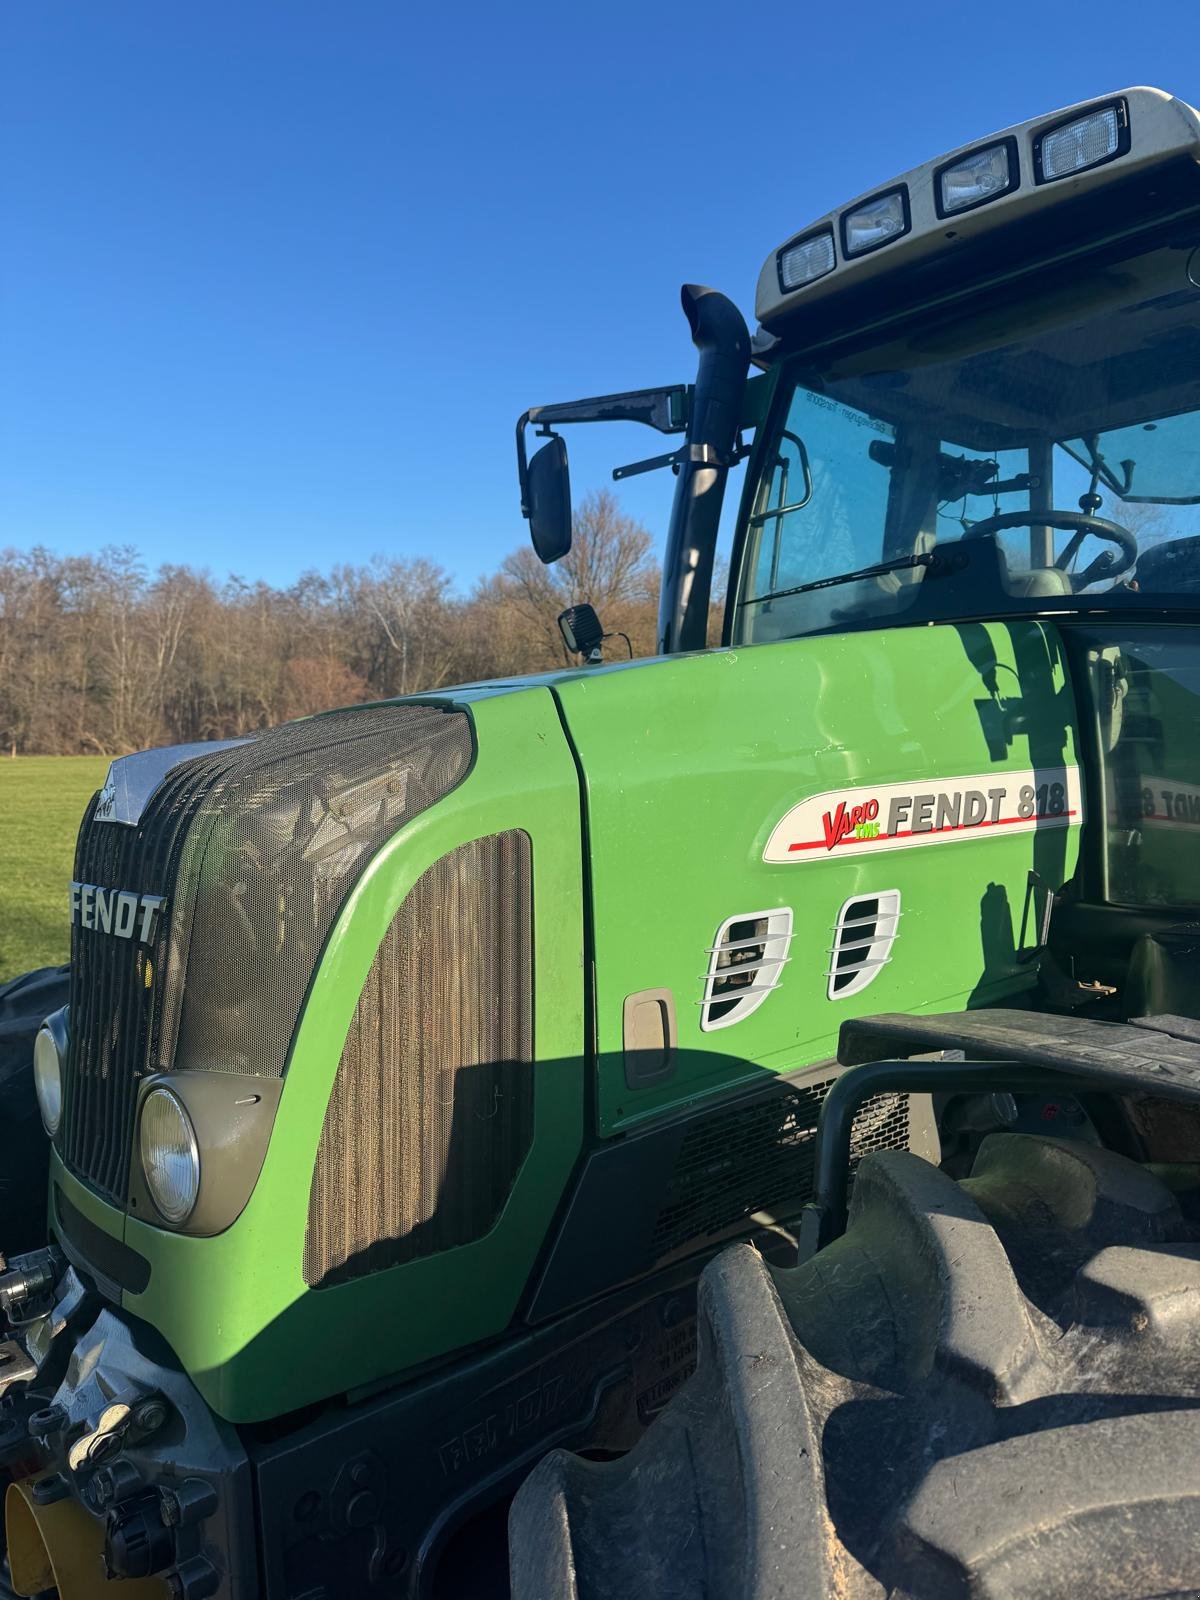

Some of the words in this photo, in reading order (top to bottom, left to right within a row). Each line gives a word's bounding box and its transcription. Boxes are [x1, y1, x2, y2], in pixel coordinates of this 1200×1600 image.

[855, 822, 880, 840] TMS
[887, 788, 1007, 837] FENDT
[1017, 782, 1065, 818] 818
[69, 881, 167, 947] FENDT
